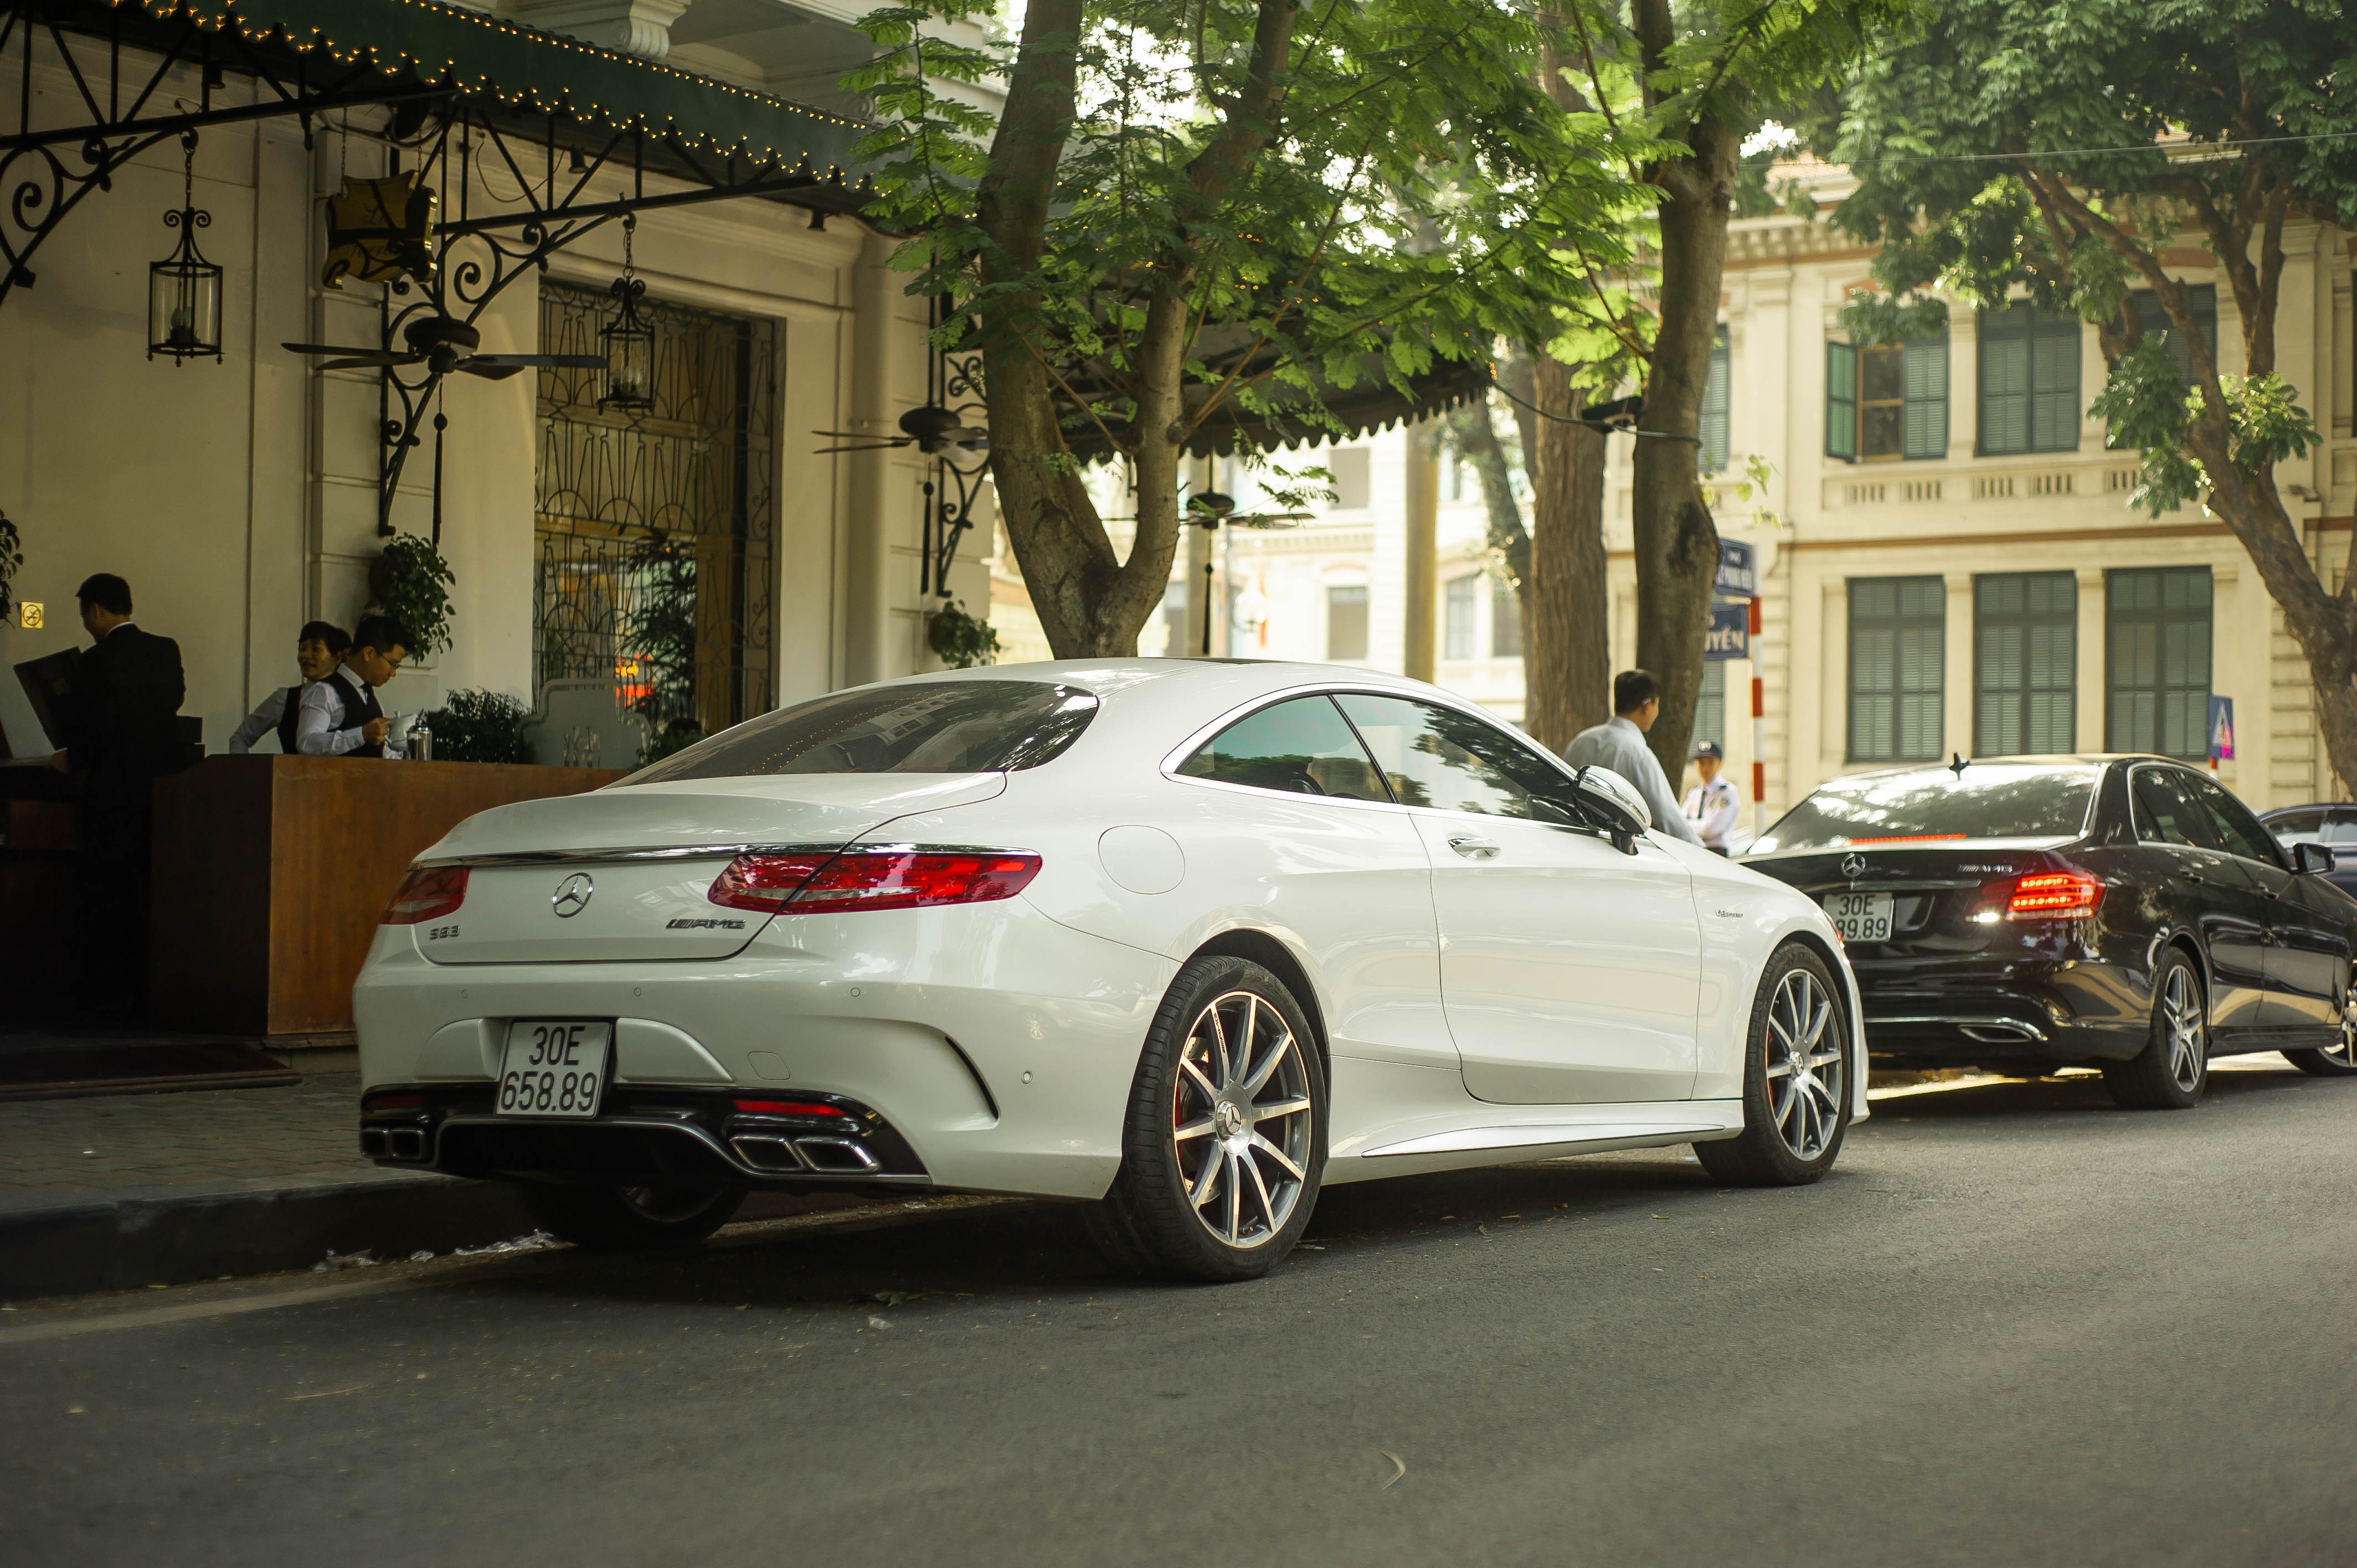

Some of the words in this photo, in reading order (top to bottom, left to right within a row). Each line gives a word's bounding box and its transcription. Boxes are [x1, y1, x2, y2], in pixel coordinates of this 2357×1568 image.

[1839, 895, 1876, 916] 30E
[691, 919, 746, 930] AMG
[1836, 917, 1887, 938] 89.89
[529, 1026, 585, 1066] 30E
[501, 1071, 597, 1112] 658.89
